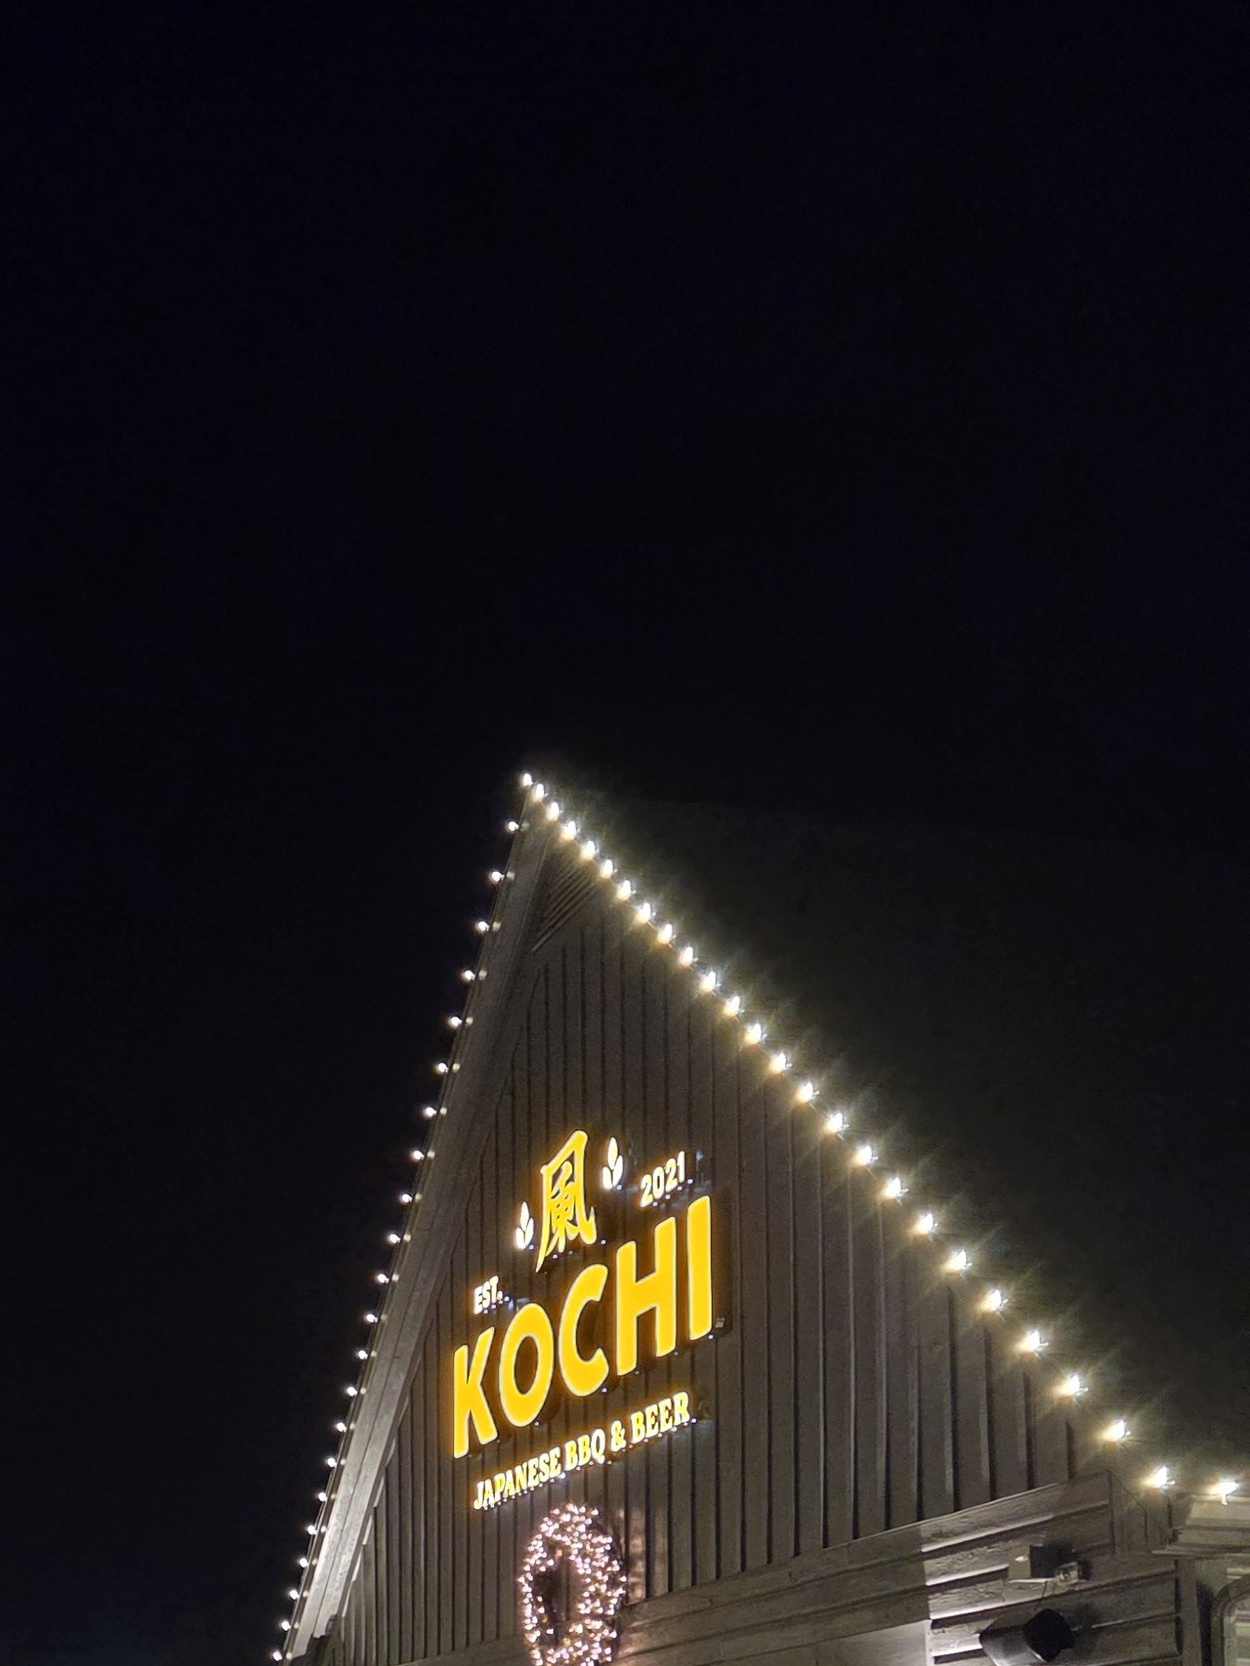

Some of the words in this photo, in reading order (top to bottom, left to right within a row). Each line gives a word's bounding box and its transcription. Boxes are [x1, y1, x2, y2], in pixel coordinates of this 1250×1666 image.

[473, 1276, 503, 1315] EST.
[640, 1150, 685, 1208] 2021
[536, 1130, 597, 1273] 風
[453, 1195, 712, 1459] KOCHI
[473, 1447, 561, 1510] JAPANESE
[564, 1428, 606, 1465] BBQ
[611, 1420, 626, 1452] &
[631, 1391, 690, 1444] BEER
